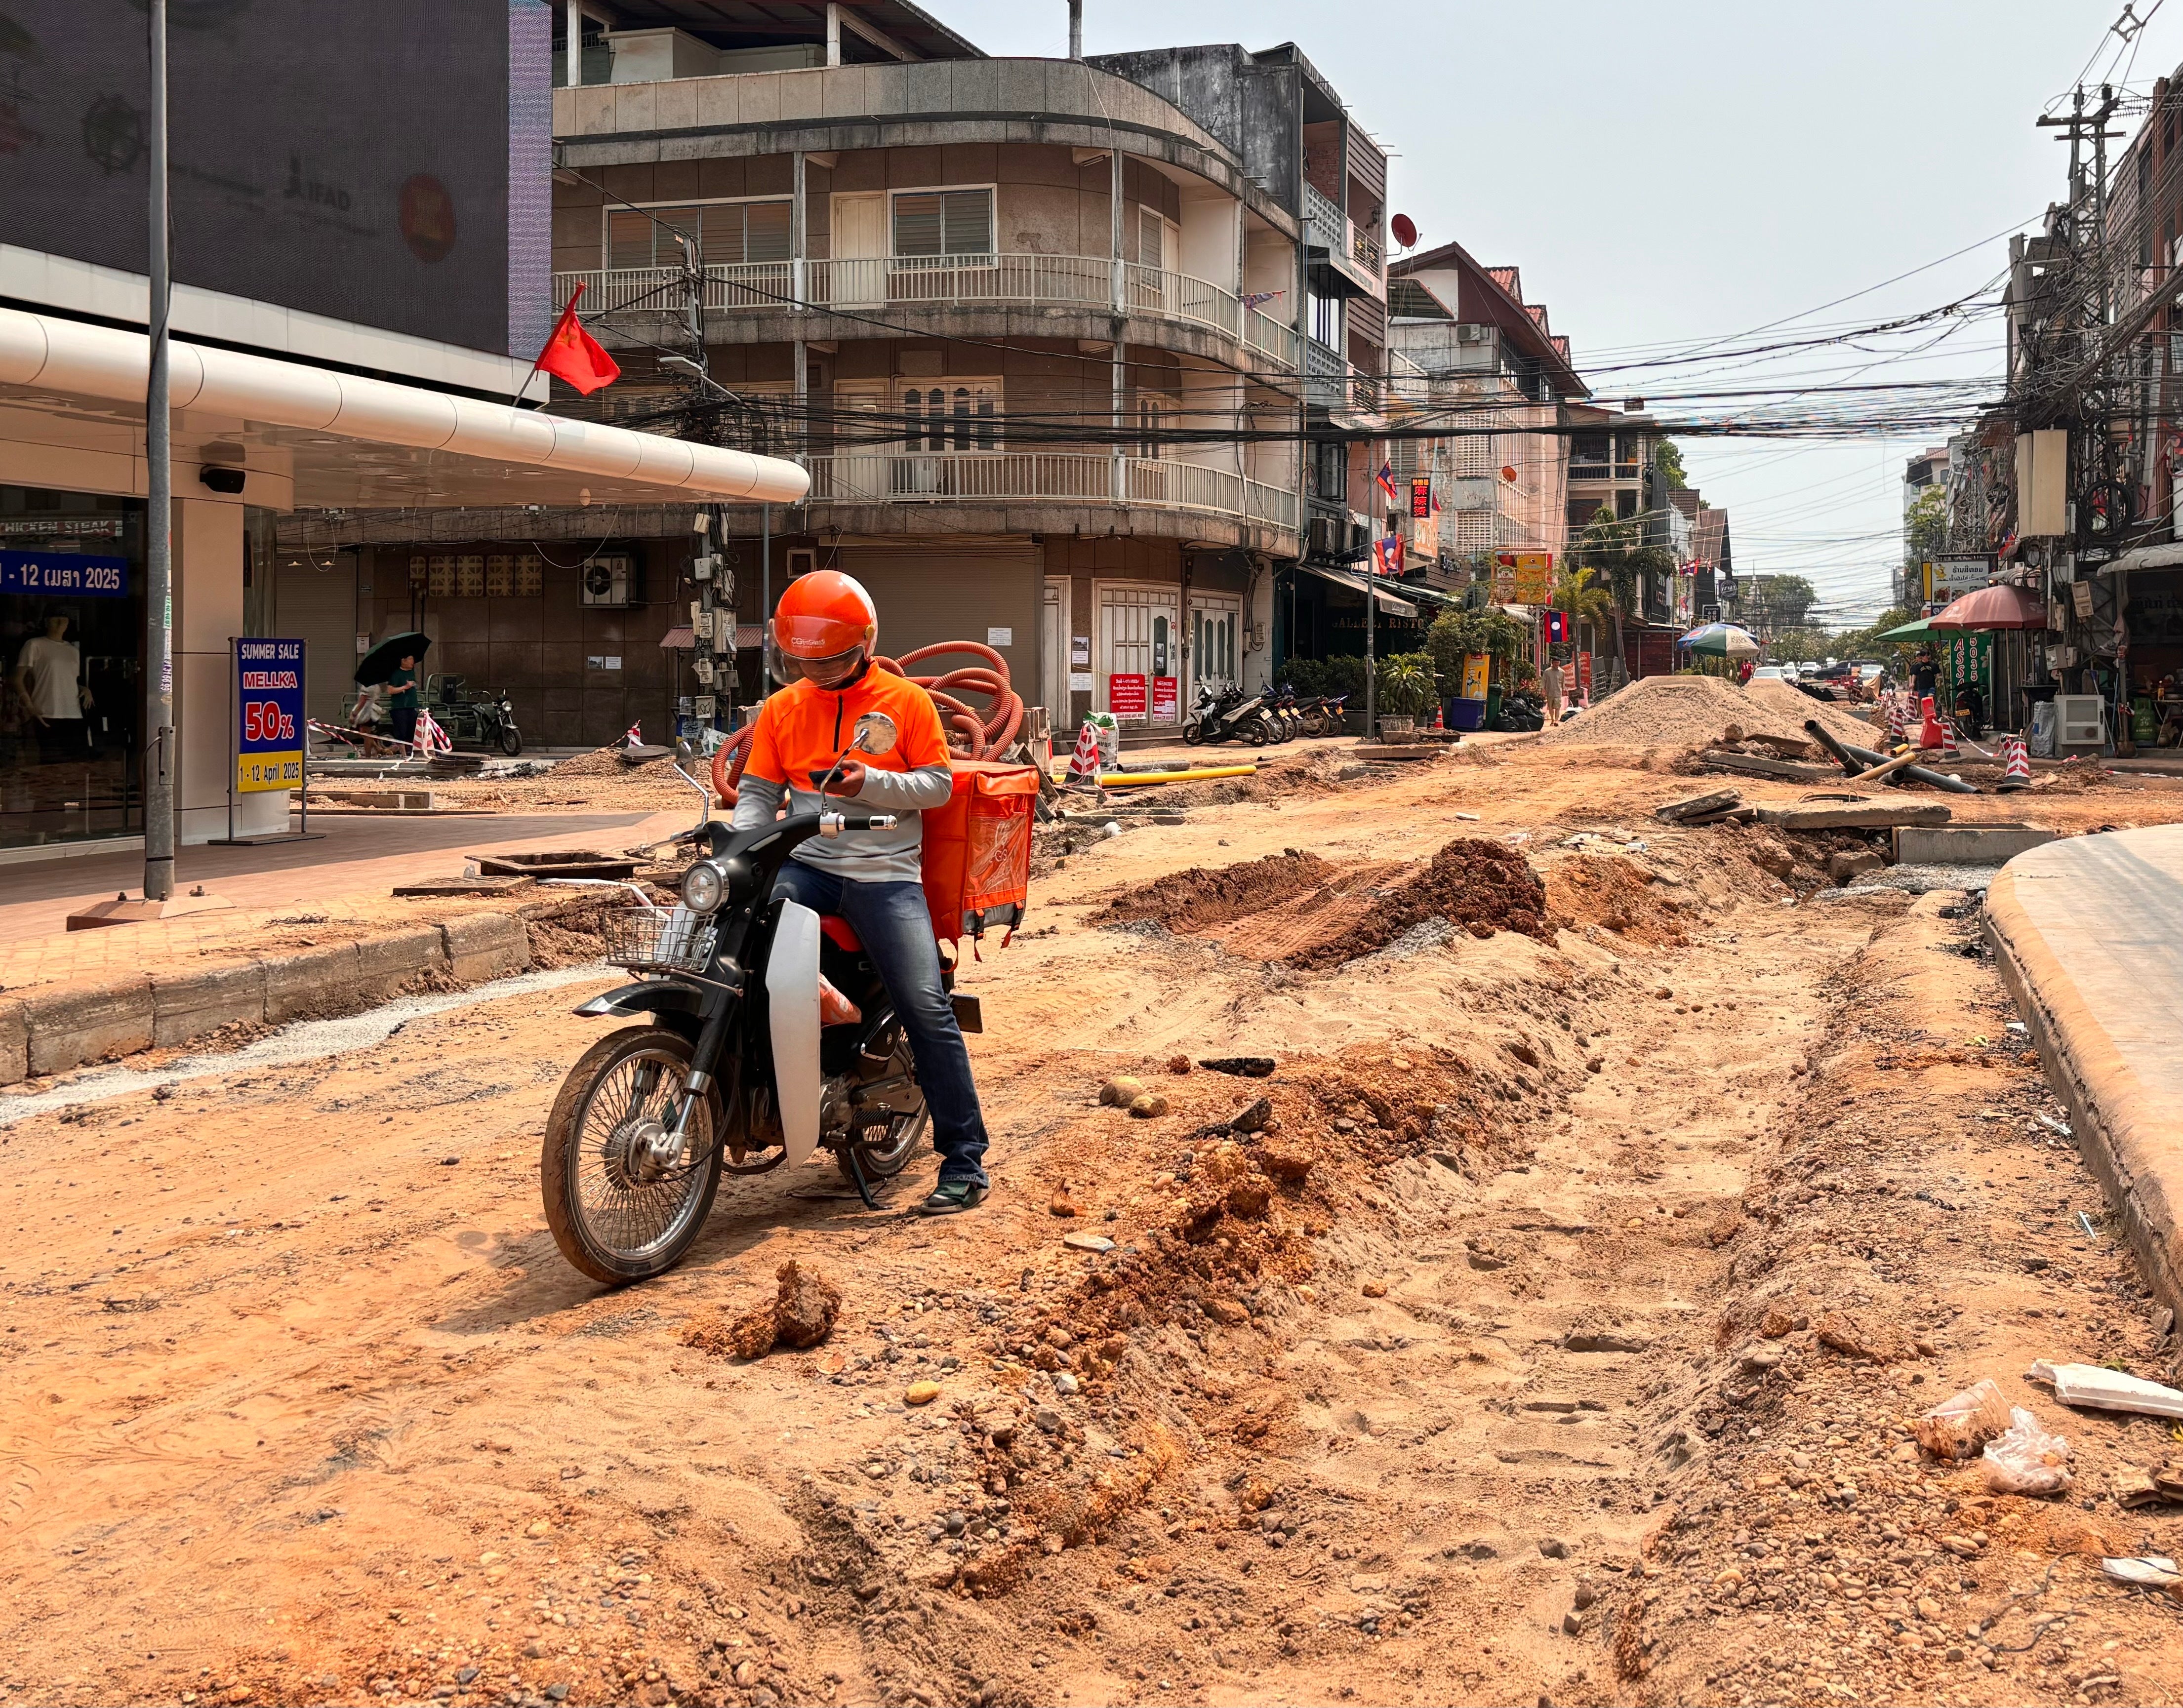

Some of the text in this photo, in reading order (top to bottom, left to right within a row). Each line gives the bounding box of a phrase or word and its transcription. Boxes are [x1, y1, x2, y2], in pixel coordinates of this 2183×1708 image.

[308, 182, 352, 211] IFAD
[0, 521, 58, 534] HICKEN
[20, 563, 39, 586] 12
[44, 569, 80, 587] ເມສາ
[85, 567, 120, 590] 2025
[242, 644, 299, 659] SUMMER SALE
[243, 672, 297, 689] MELLKA
[245, 701, 294, 741] 50%
[240, 766, 243, 782] 1
[252, 765, 260, 782] 12
[264, 763, 279, 785] April
[283, 762, 299, 779] 2025
